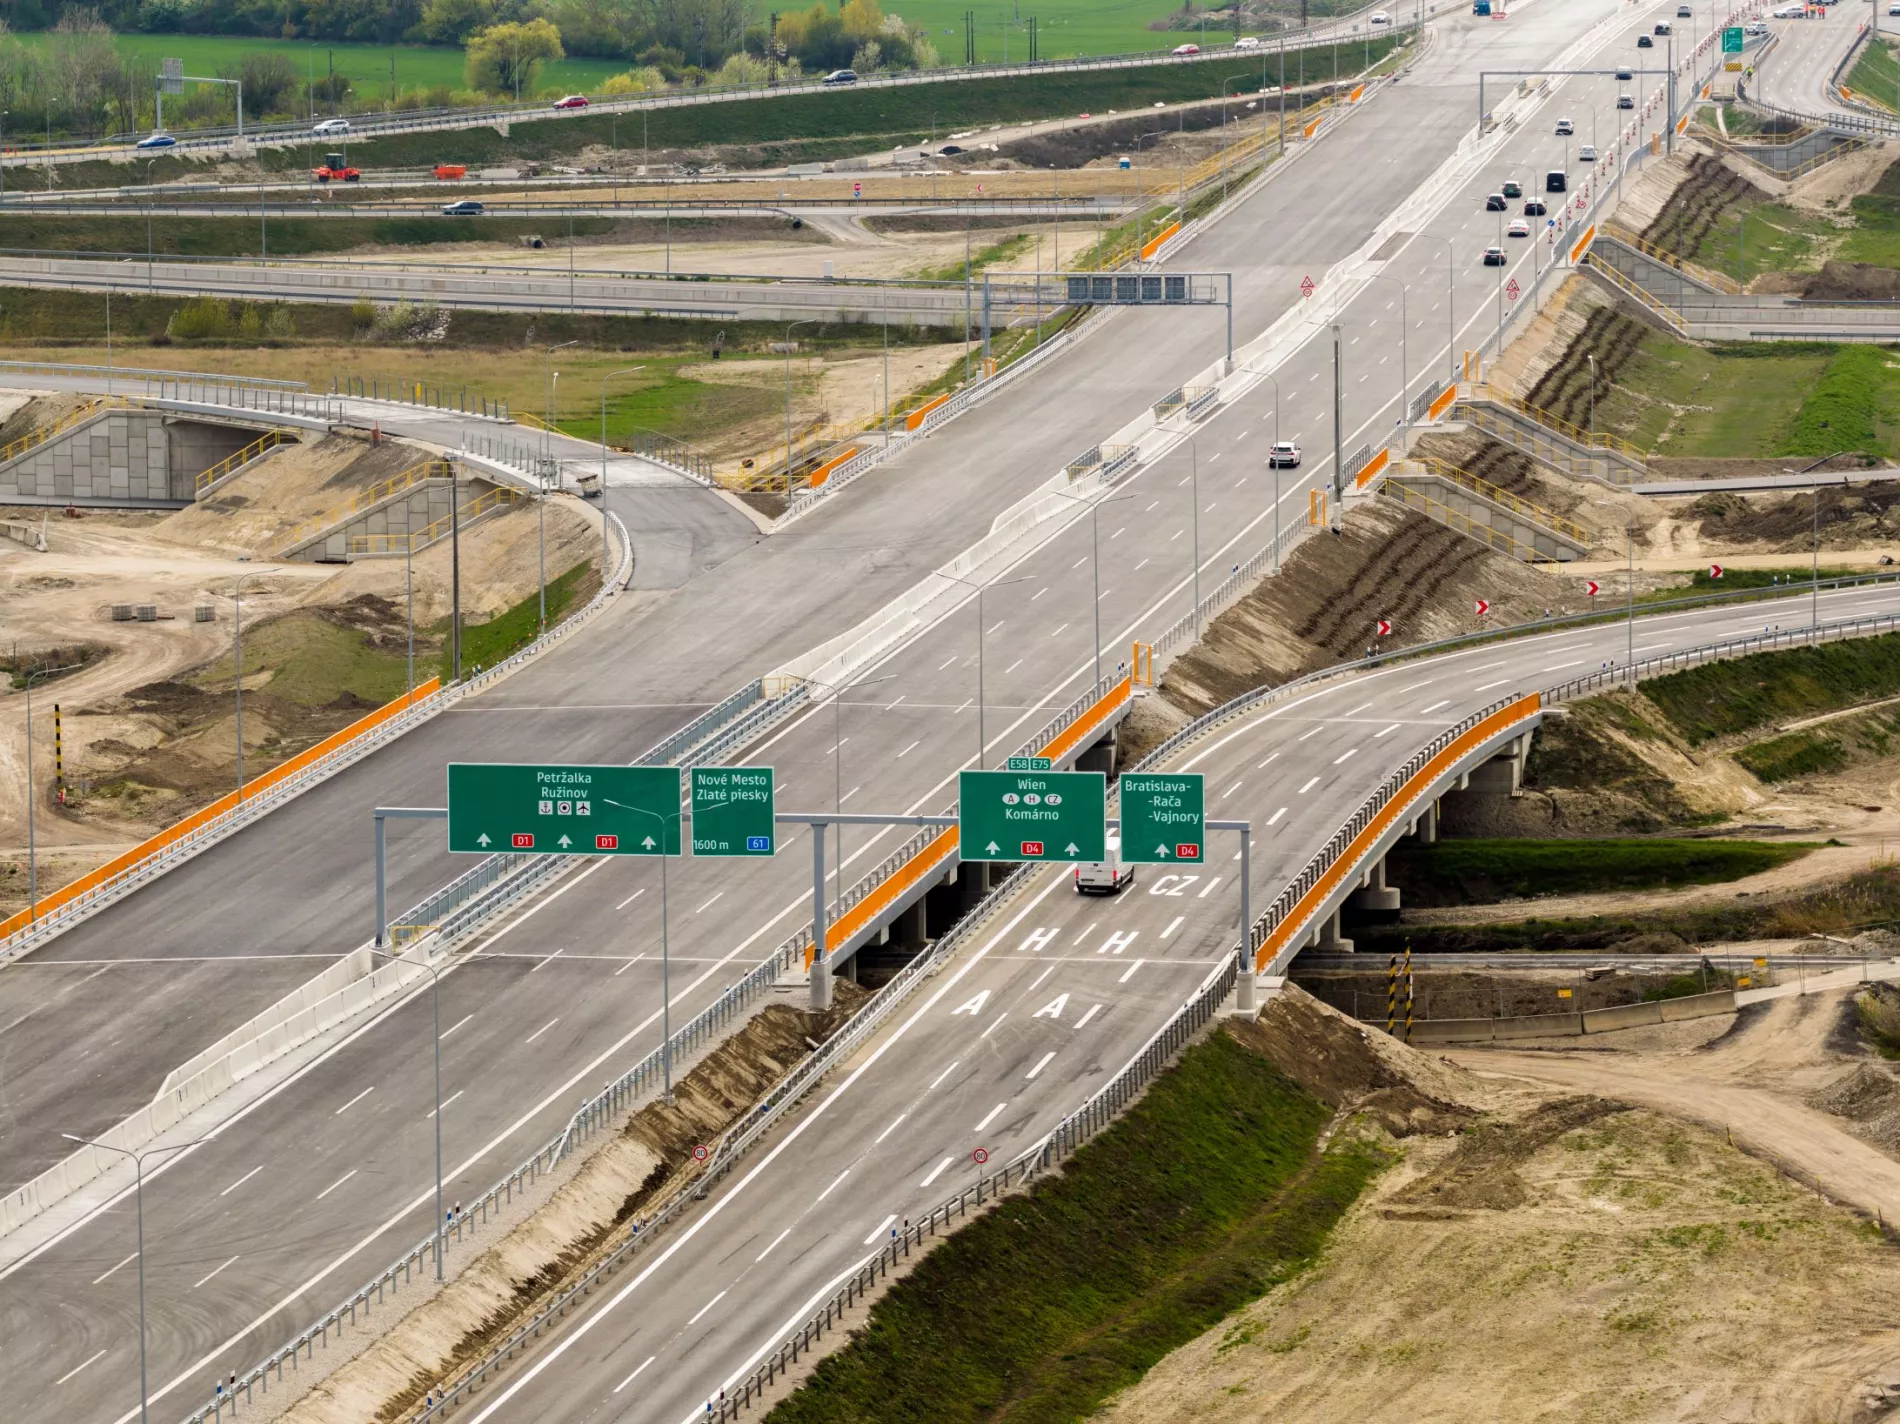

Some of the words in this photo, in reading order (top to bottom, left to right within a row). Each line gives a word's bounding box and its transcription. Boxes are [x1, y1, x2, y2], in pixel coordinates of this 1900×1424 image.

[1009, 758, 1028, 770] E58
[1031, 759, 1049, 770] E75
[537, 772, 591, 784] Petržalka
[698, 774, 727, 786] Nové
[732, 775, 766, 786] Mesto
[1018, 779, 1046, 790] Wien
[1125, 781, 1191, 792] Bratislava-
[542, 787, 588, 798] Ružinov
[697, 789, 727, 800] Zlaté
[731, 790, 768, 802] piesky
[1047, 794, 1060, 805] CZ
[1148, 796, 1181, 807] -Rača
[1005, 809, 1059, 820] Komárno
[1148, 811, 1199, 824] -Vajnory
[693, 840, 717, 850] 1600
[719, 841, 730, 851] m
[1026, 844, 1039, 854] D4
[1181, 846, 1194, 856] D4
[1149, 875, 1199, 896] CZ
[1018, 928, 1060, 951] H
[1097, 931, 1140, 954] H
[951, 990, 992, 1015] A
[1032, 993, 1070, 1018] A
[696, 1148, 706, 1158] 80
[976, 1150, 986, 1160] 80
